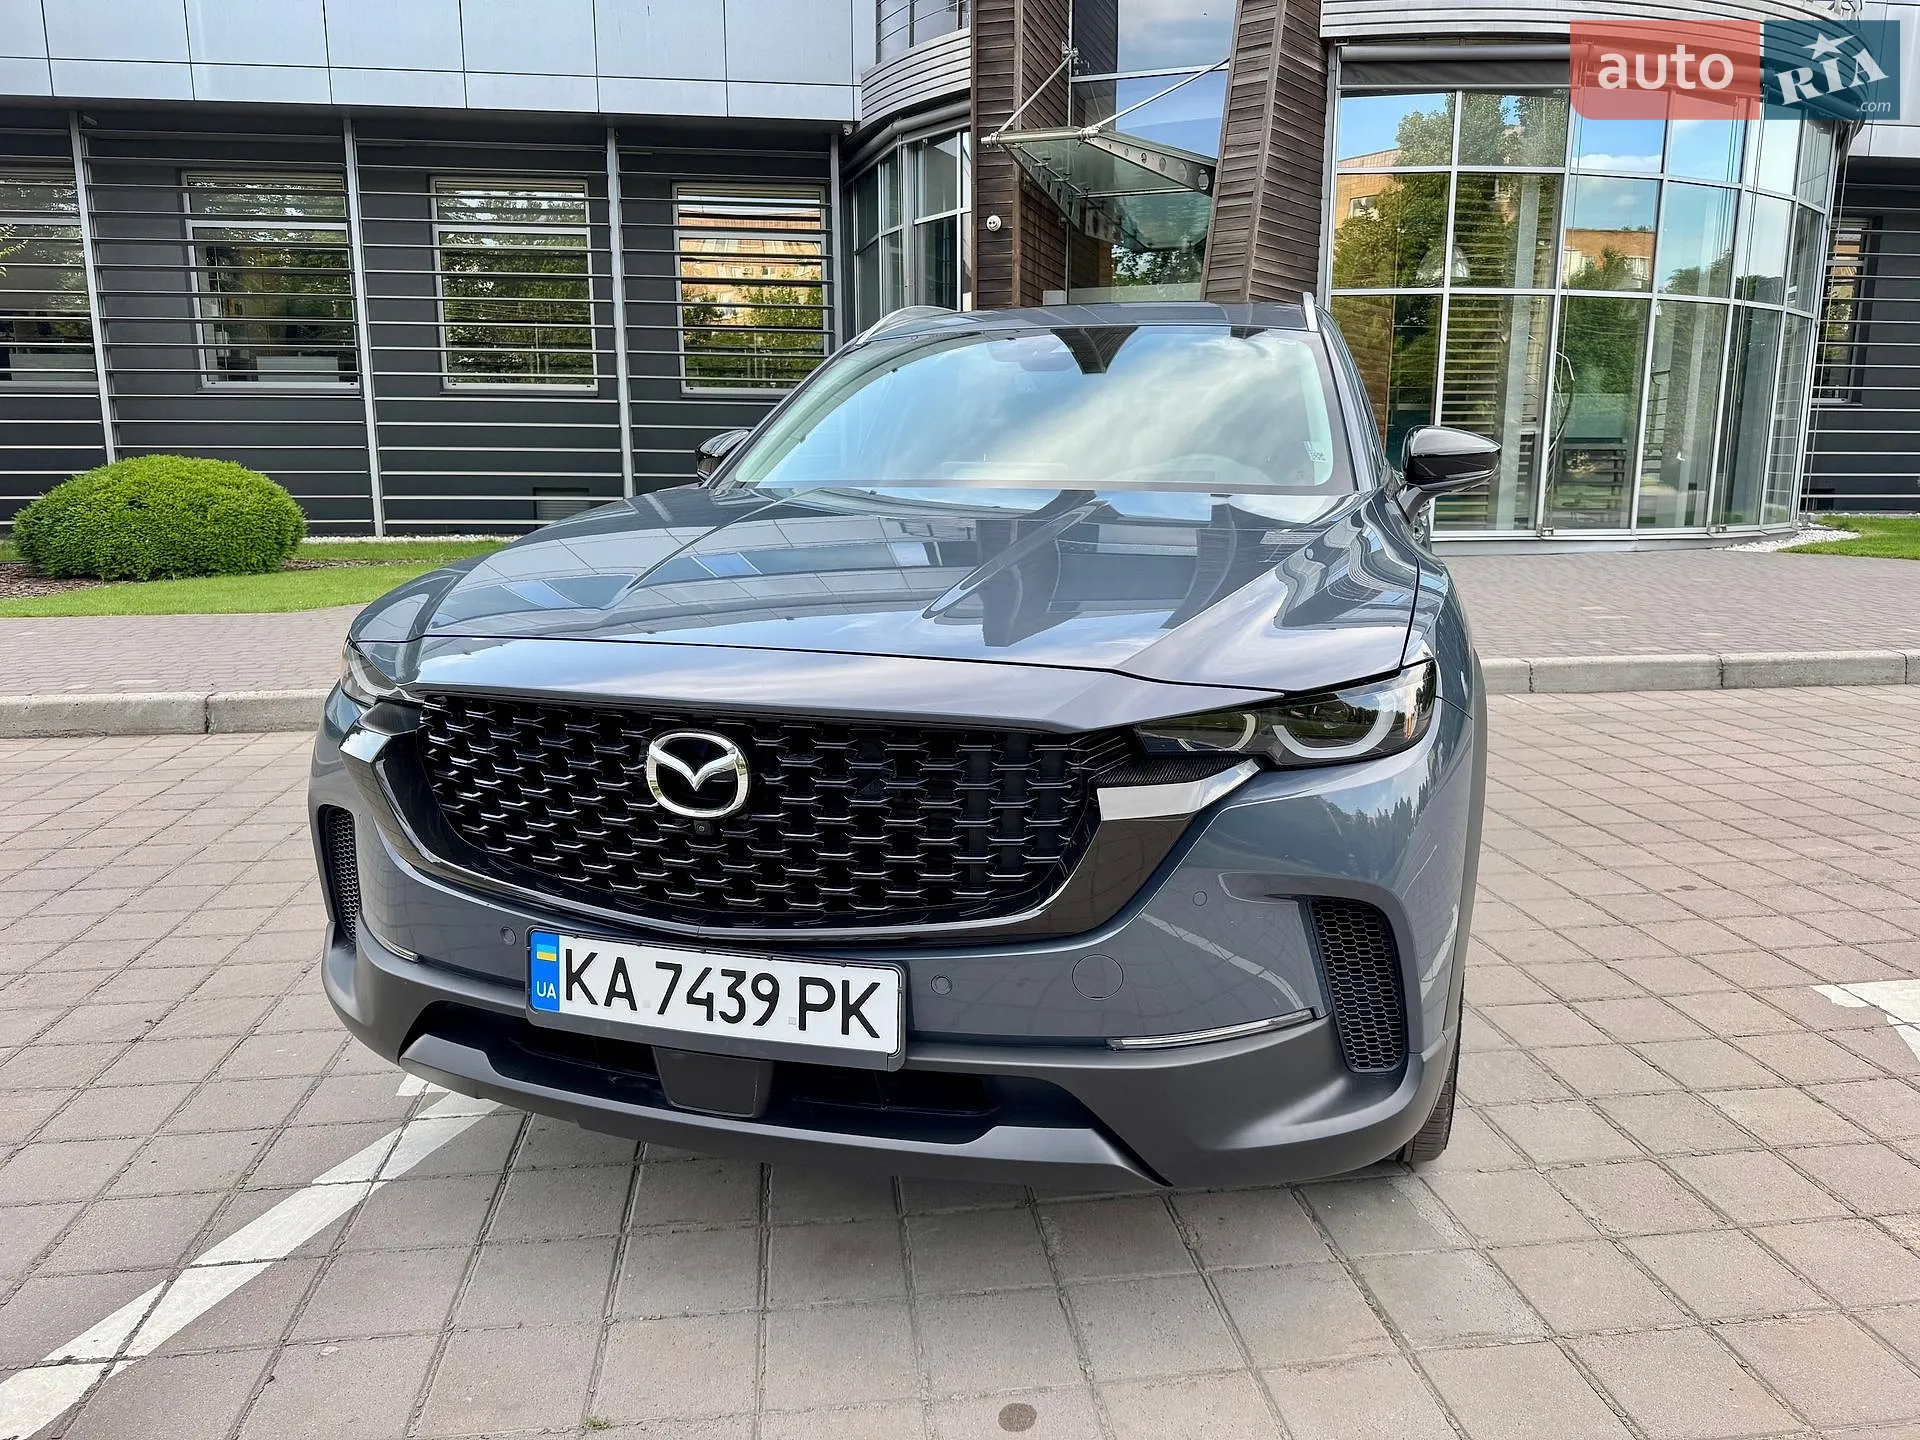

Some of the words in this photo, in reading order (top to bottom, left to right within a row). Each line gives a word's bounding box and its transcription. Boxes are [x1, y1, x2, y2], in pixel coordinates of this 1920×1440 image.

[536, 980, 557, 1000] UA
[564, 948, 638, 1012] KA
[655, 961, 780, 1027] 7439
[798, 976, 881, 1039] PK
